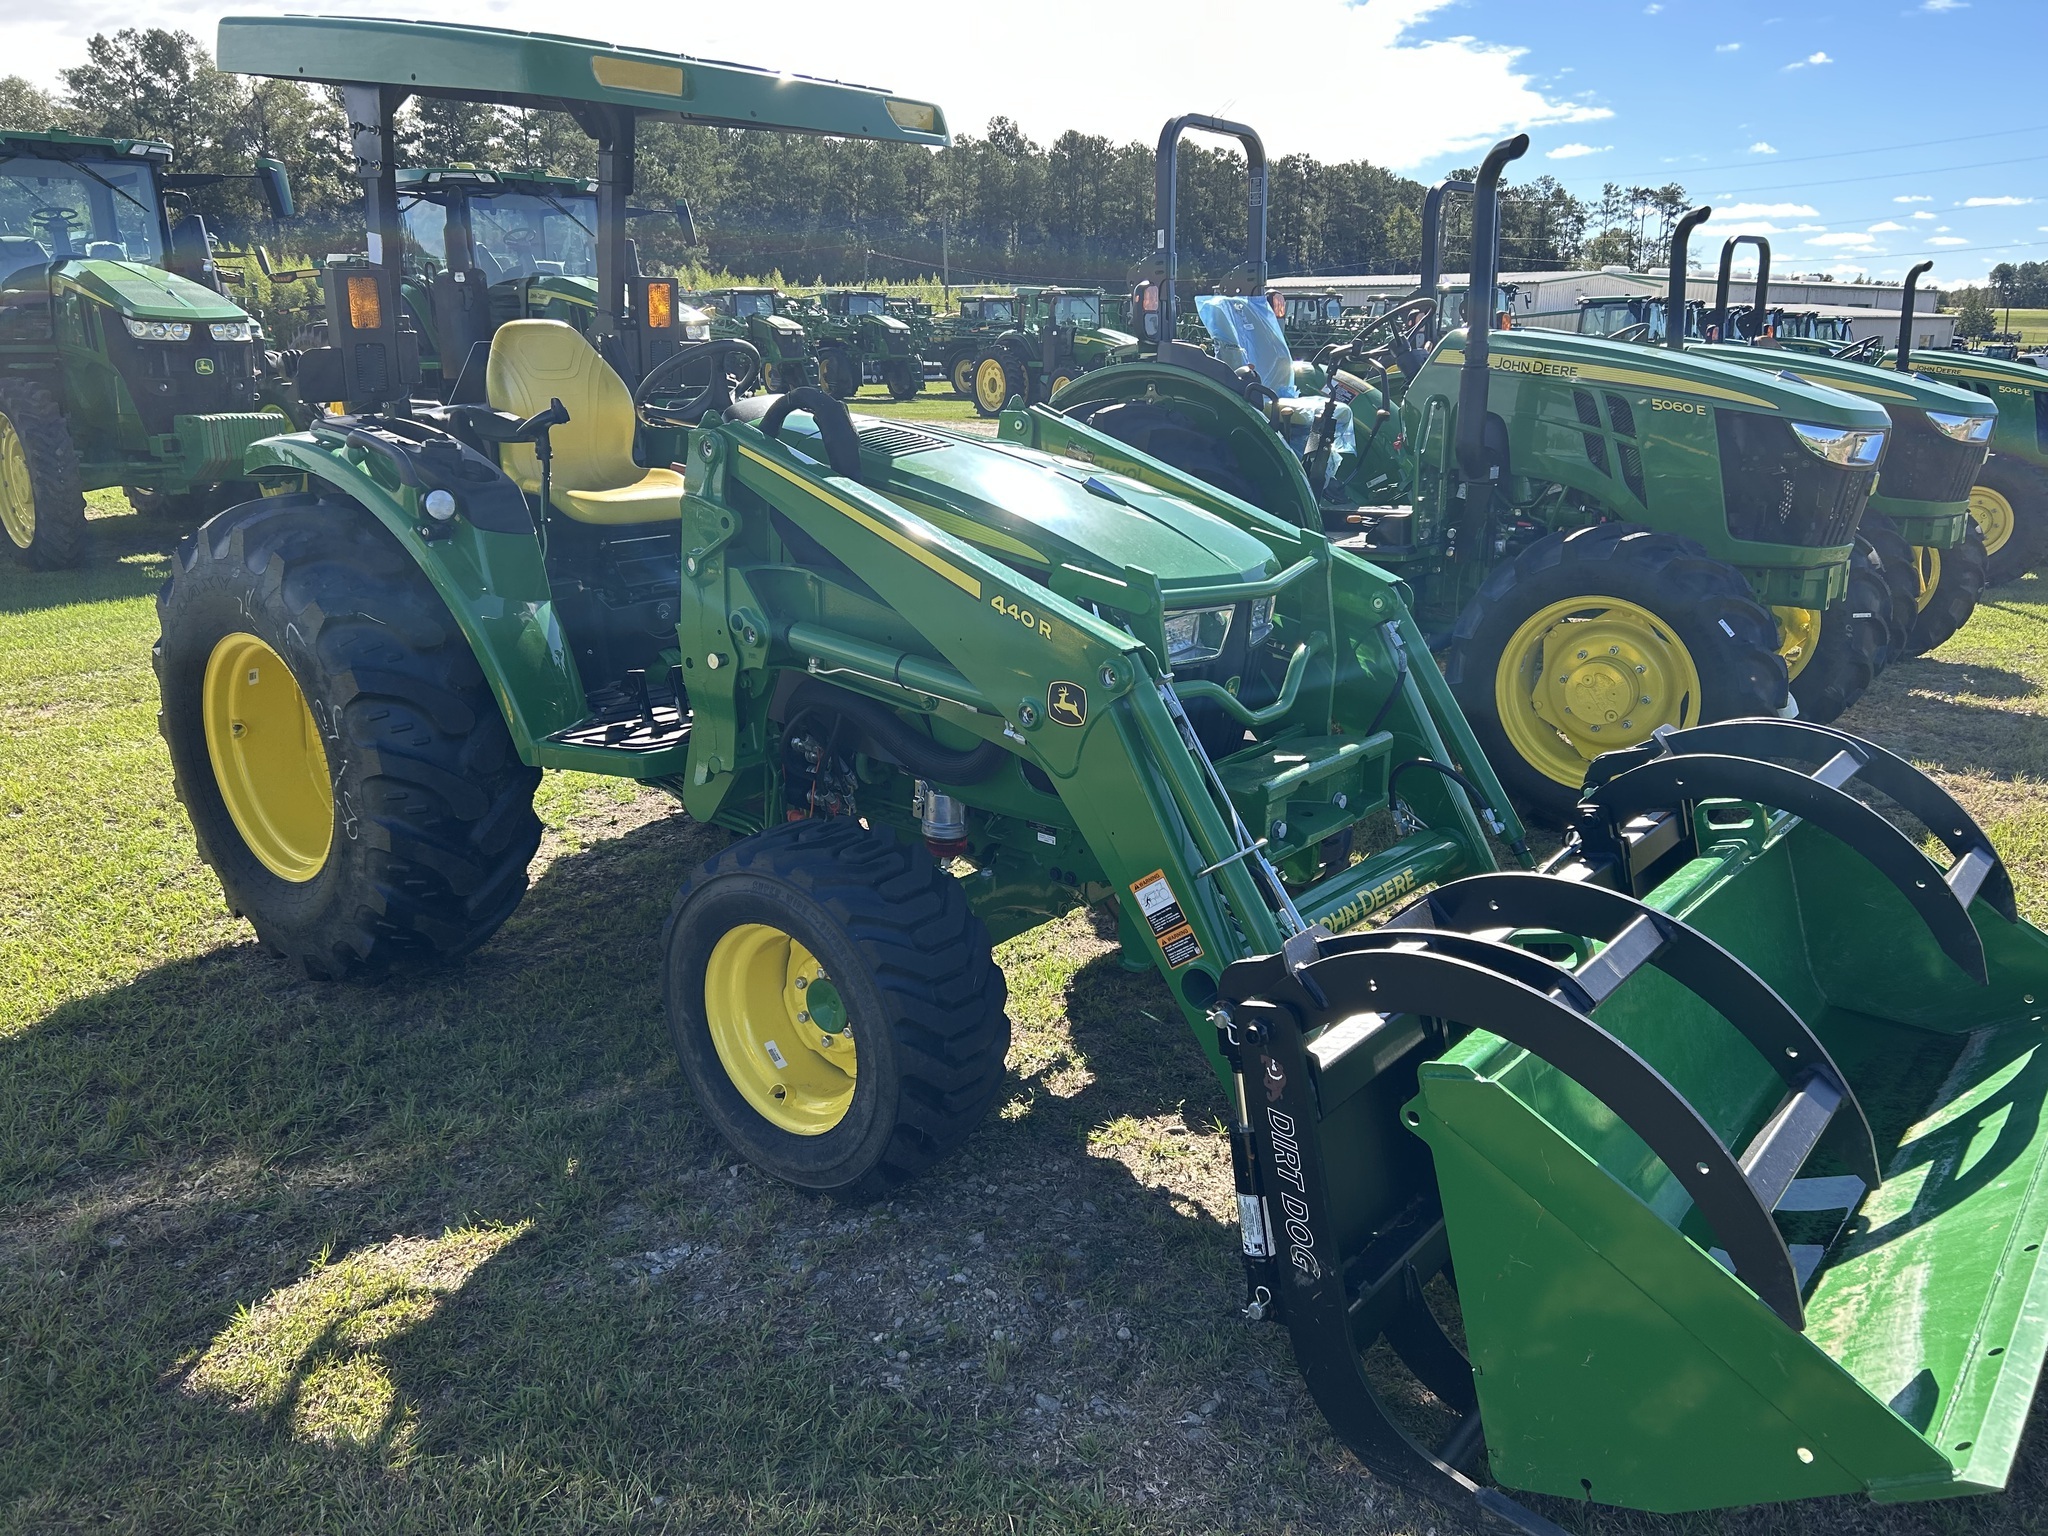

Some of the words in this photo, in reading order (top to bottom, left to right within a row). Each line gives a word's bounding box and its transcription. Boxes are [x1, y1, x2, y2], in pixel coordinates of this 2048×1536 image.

[1496, 357, 1530, 373] JOHN
[1533, 361, 1578, 377] DEERE
[1915, 364, 1935, 373] JOHN
[1936, 366, 1961, 375] DEERE
[1999, 386, 2022, 395] 5045
[1652, 399, 1694, 414] 5060
[1696, 405, 1706, 415] E
[990, 595, 1035, 628] 440
[1039, 618, 1052, 640] R
[1139, 873, 1160, 887] WARNING
[1356, 868, 1416, 916] DEERE
[1167, 929, 1189, 942] WARNING
[1267, 1107, 1305, 1193] DIRT
[1281, 1192, 1321, 1279] DOG
